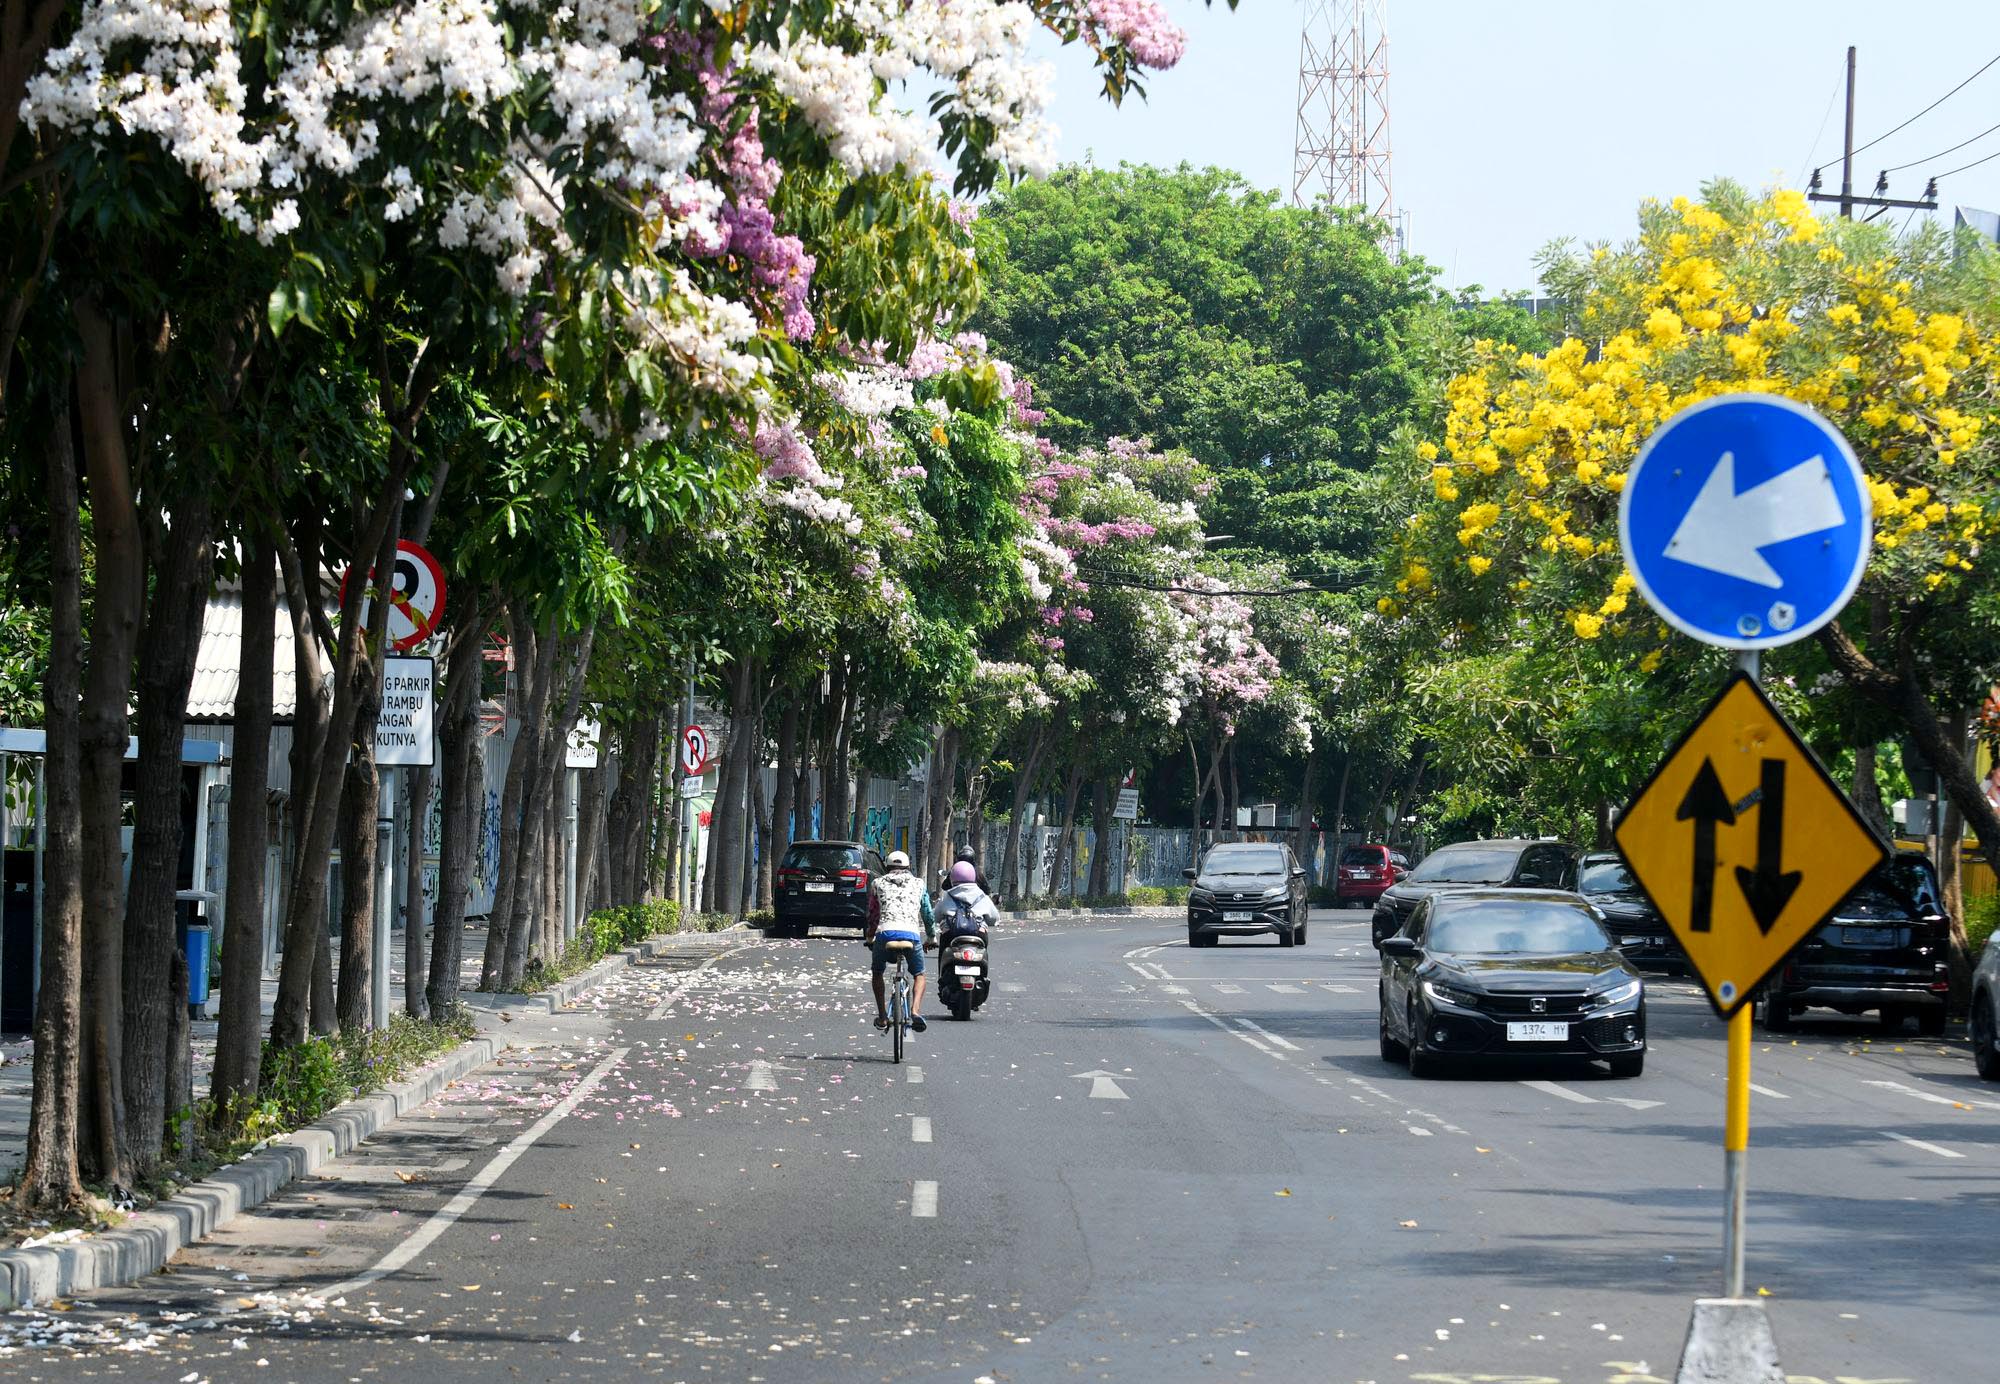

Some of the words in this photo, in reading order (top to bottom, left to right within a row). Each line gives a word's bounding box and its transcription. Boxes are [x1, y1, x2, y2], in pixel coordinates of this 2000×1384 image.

[394, 677, 430, 691] PARKIR
[387, 696, 423, 710] RAMBU
[377, 713, 413, 728] ANGAN
[377, 732, 417, 746] KUTNYA
